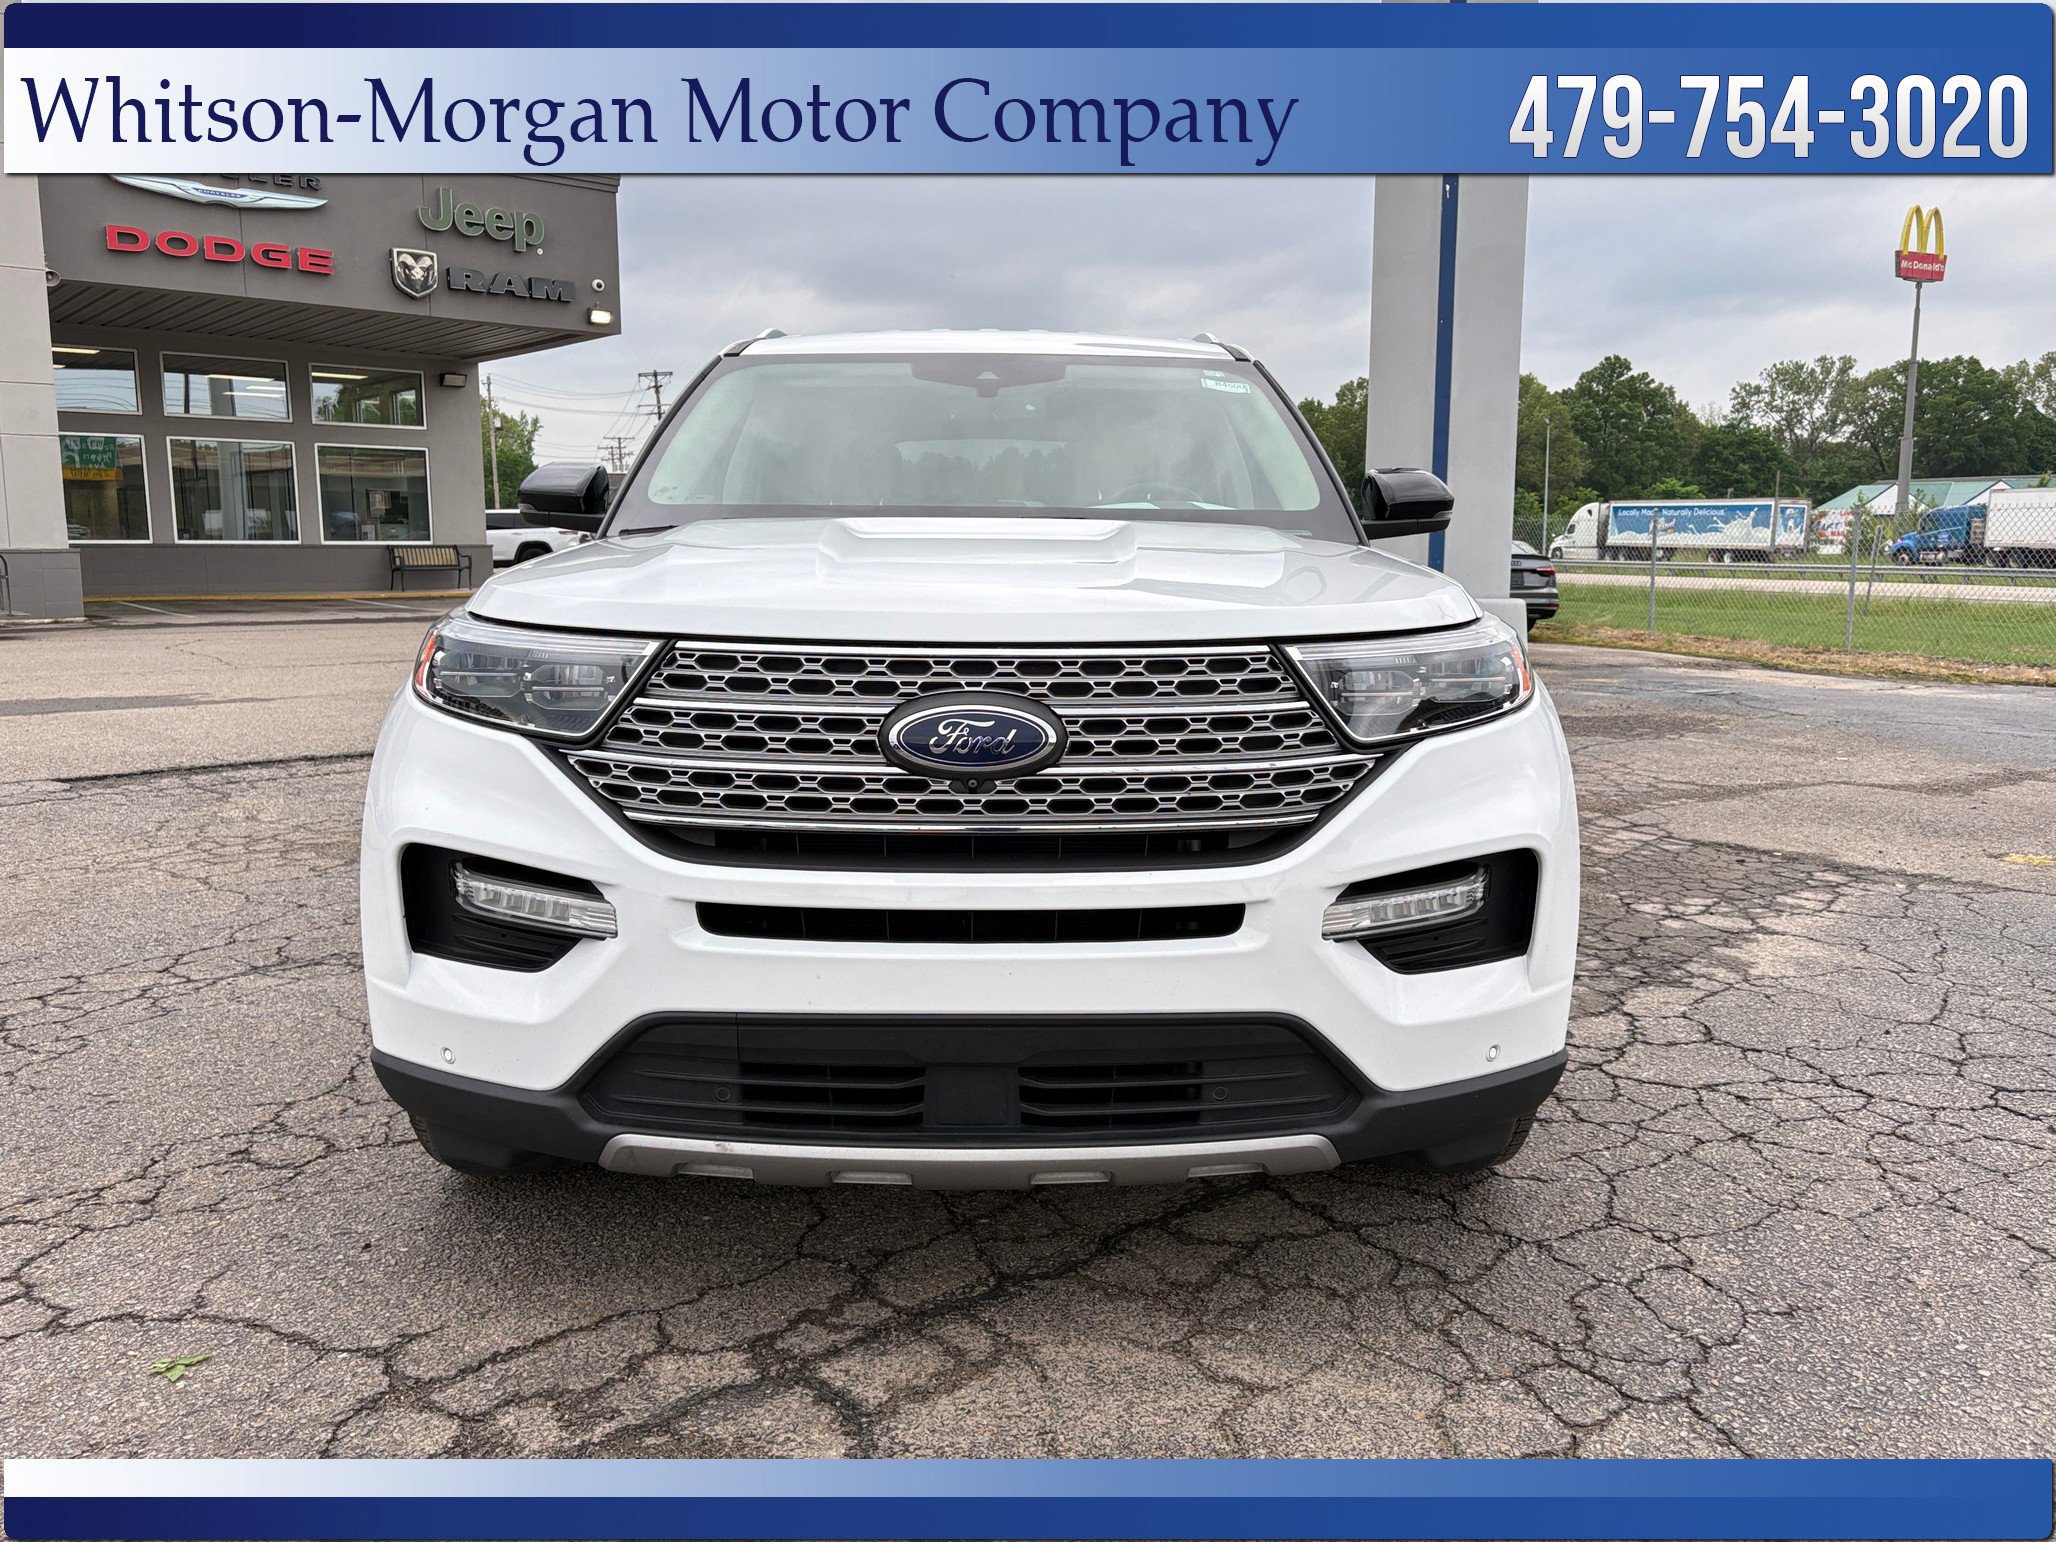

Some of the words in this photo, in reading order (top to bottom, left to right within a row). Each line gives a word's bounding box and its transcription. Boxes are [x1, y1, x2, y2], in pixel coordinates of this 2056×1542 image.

[416, 186, 545, 252] Jeep
[105, 223, 335, 275] DODGE
[446, 265, 576, 302] RAM
[1618, 508, 1640, 517] Locally
[1662, 508, 1693, 517] Naturally
[928, 718, 1018, 755] Ford
